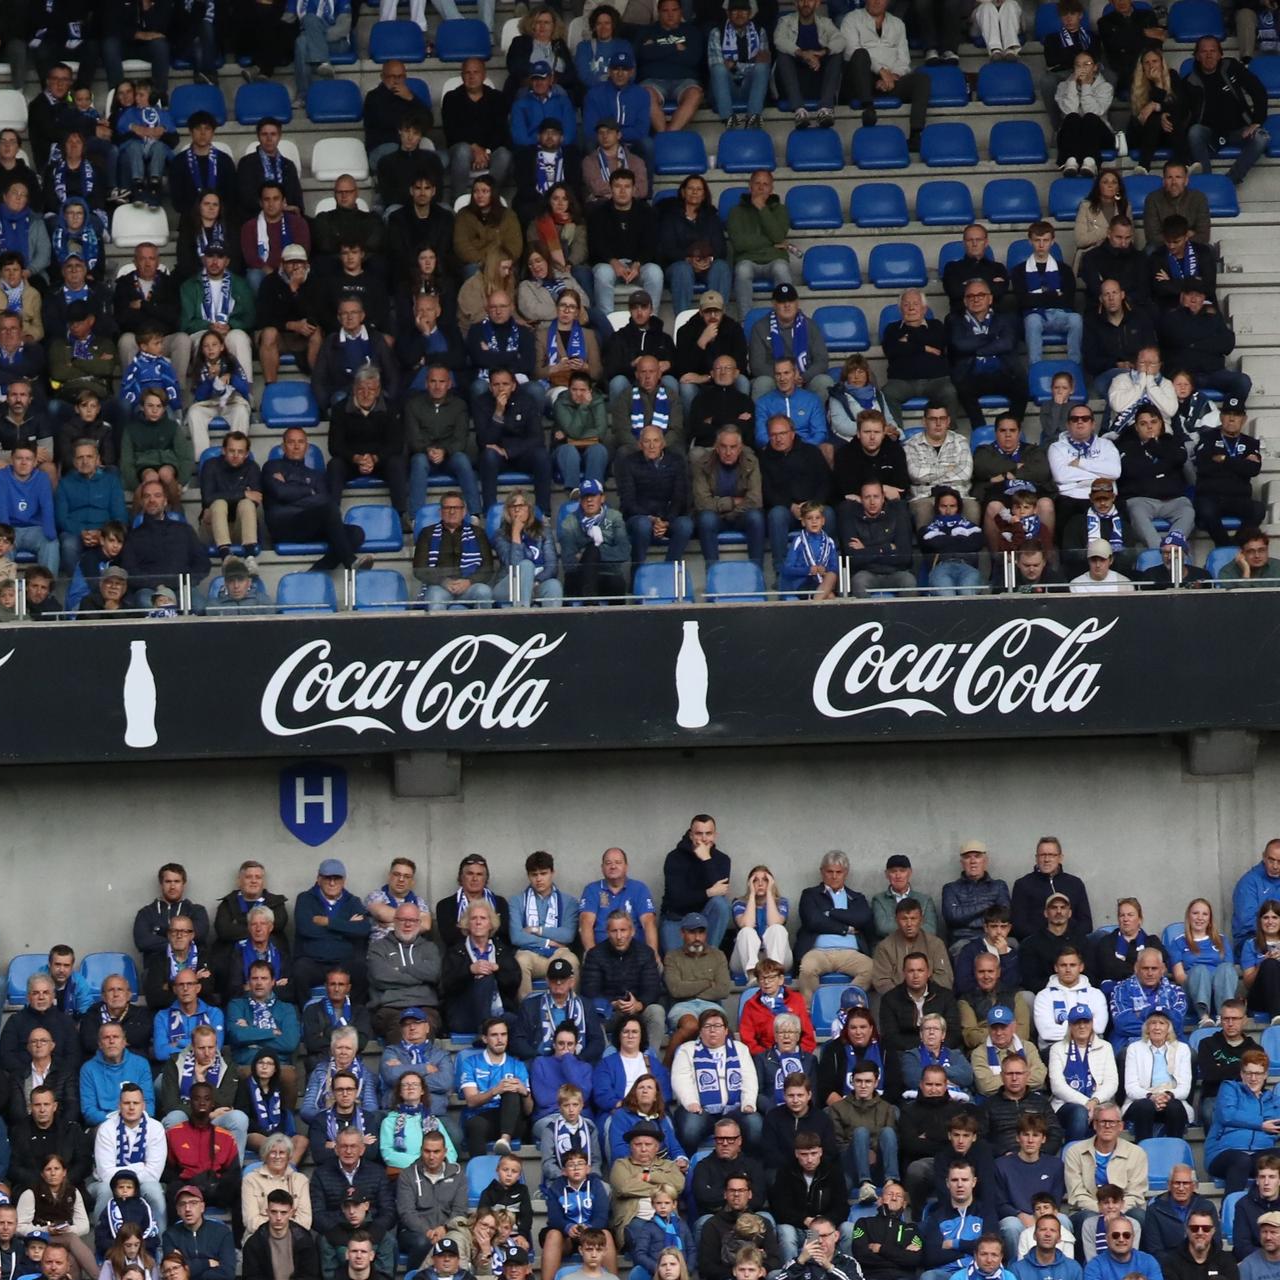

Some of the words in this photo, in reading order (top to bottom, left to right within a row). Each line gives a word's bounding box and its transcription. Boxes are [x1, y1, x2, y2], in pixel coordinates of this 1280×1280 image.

[261, 632, 567, 736] Coca-Cola
[813, 616, 1119, 718] Coca-Cola
[295, 776, 333, 825] H
